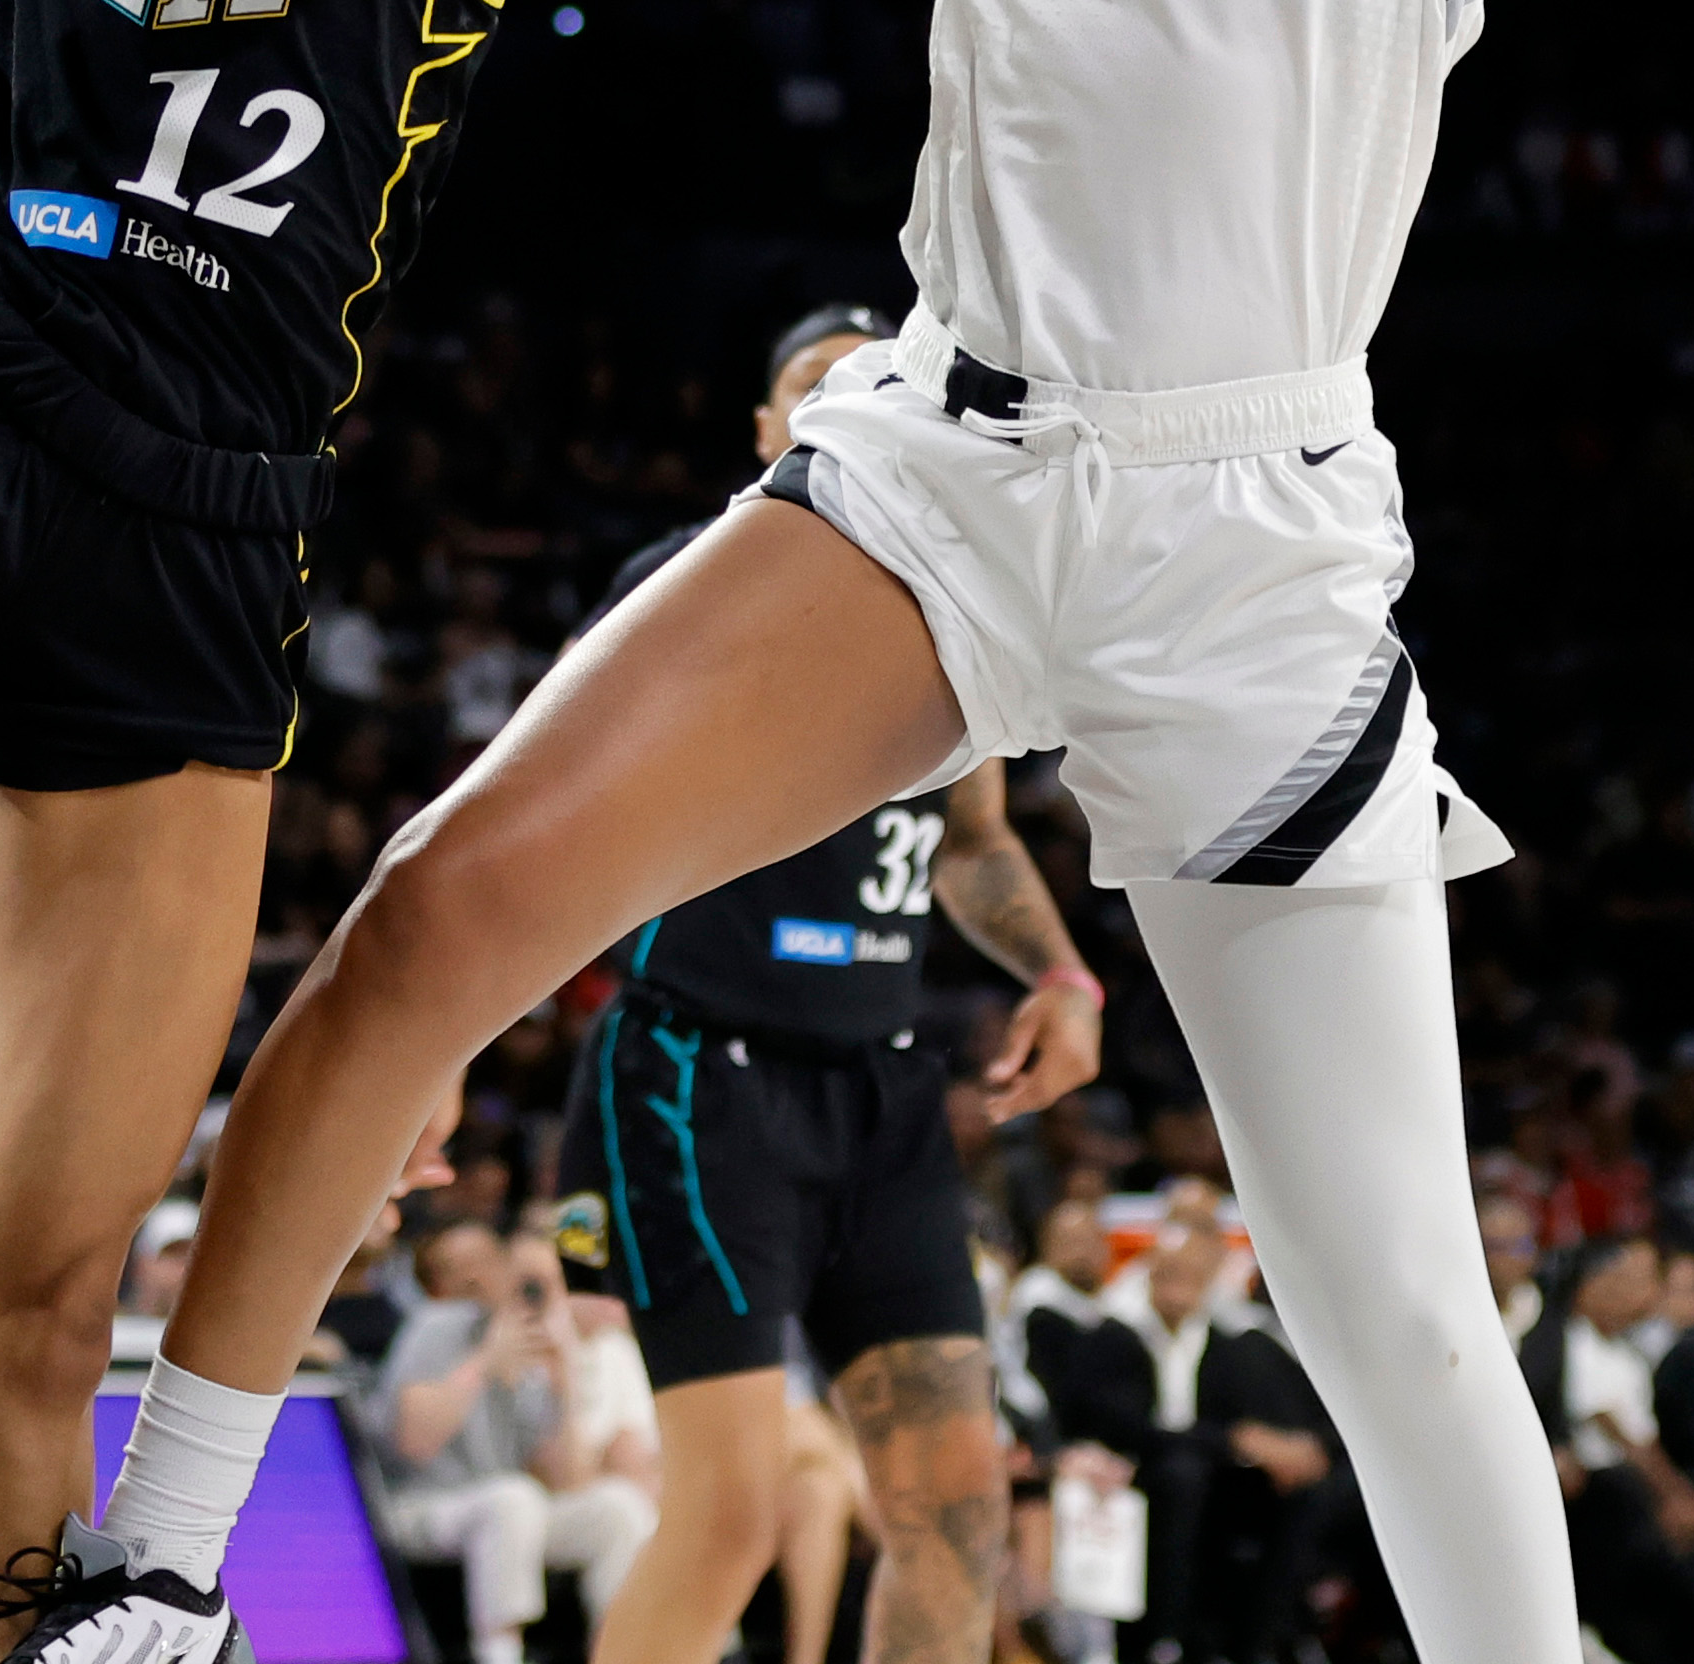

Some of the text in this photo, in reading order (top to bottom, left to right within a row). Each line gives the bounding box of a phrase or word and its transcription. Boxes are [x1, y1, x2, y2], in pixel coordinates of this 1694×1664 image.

[115, 68, 325, 237] 12
[18, 203, 231, 292] UCLA Health
[860, 808, 945, 916] 32
